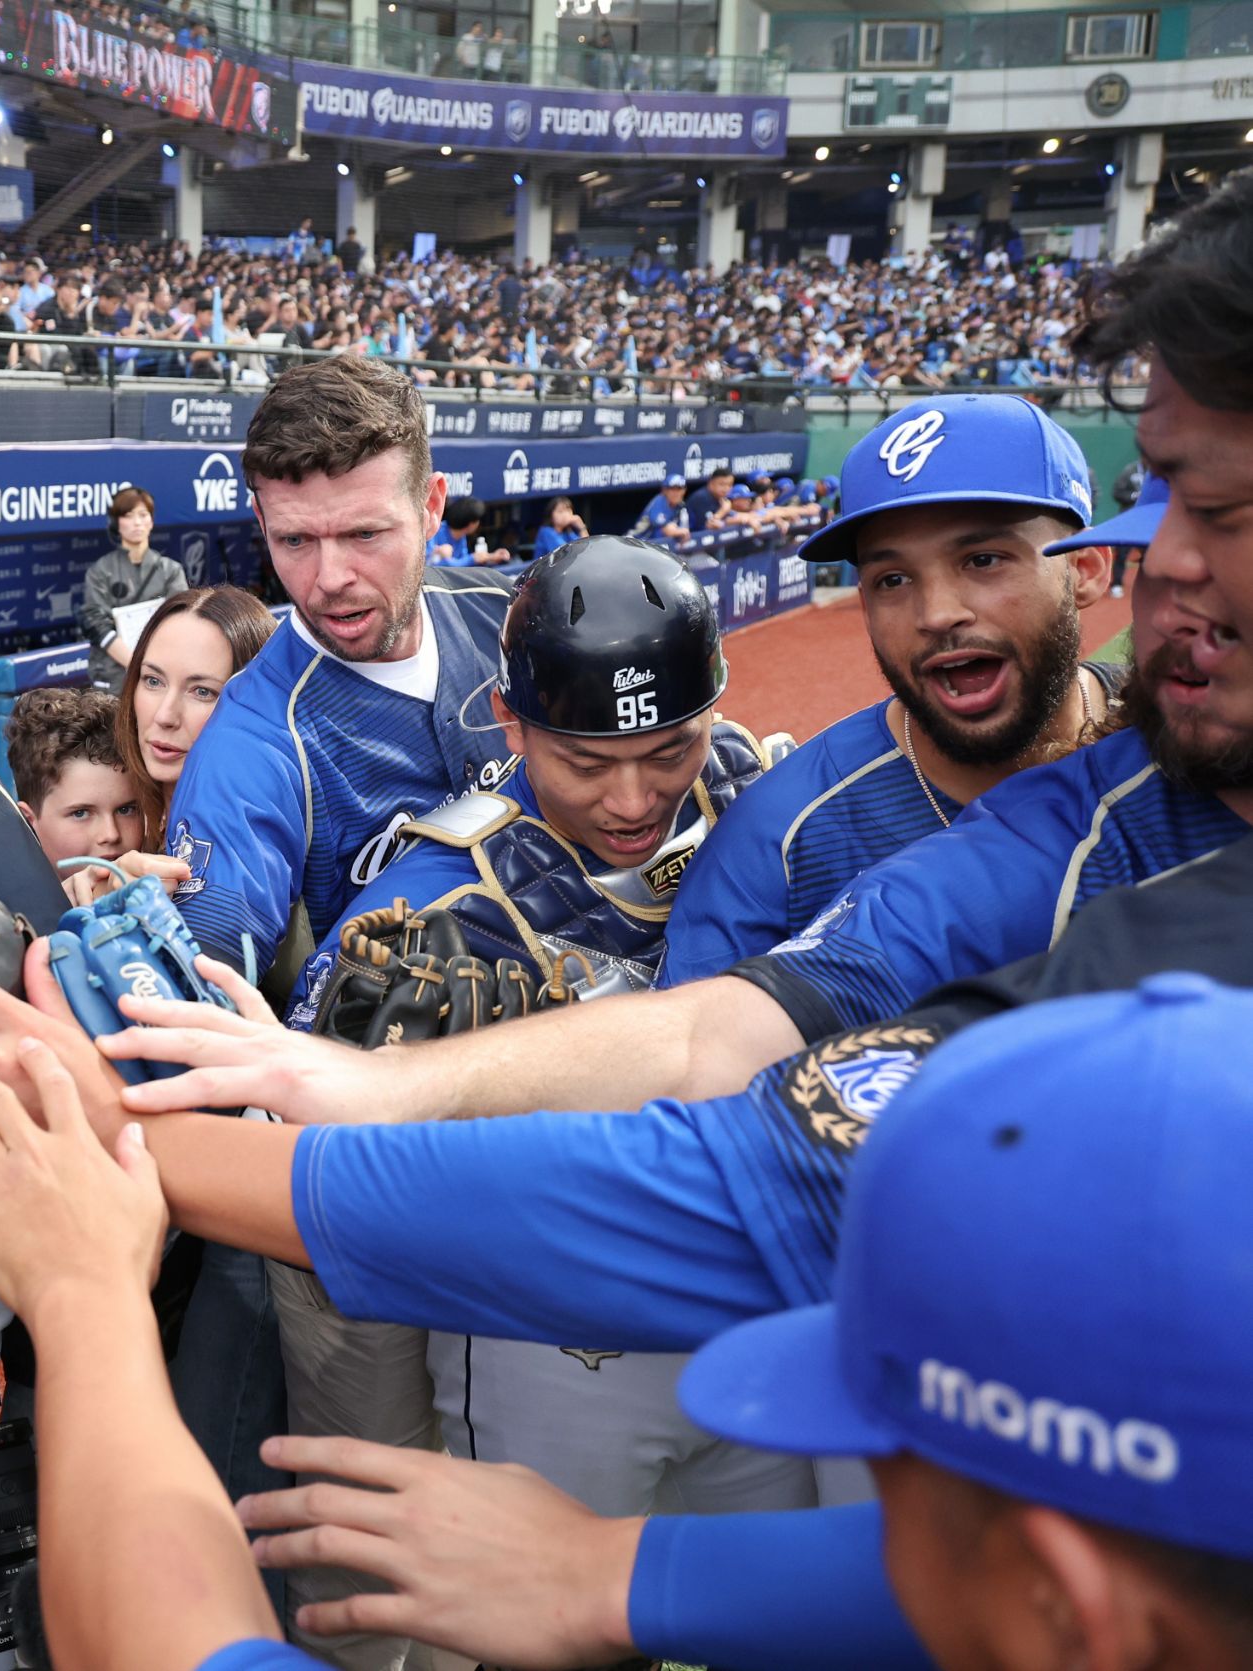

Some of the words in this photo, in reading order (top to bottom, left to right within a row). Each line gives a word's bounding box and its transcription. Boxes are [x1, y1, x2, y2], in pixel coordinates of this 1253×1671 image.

[52, 10, 128, 83] BLUE
[129, 41, 220, 120] POWER
[301, 82, 370, 118] FUBON
[371, 86, 494, 130] GUARDIANS
[539, 106, 611, 136] FUBON
[613, 104, 744, 142] GUARDIANS
[192, 478, 238, 511] YKE
[613, 666, 656, 693] Fubon
[617, 691, 659, 730] 95
[919, 1358, 1180, 1484] momo
